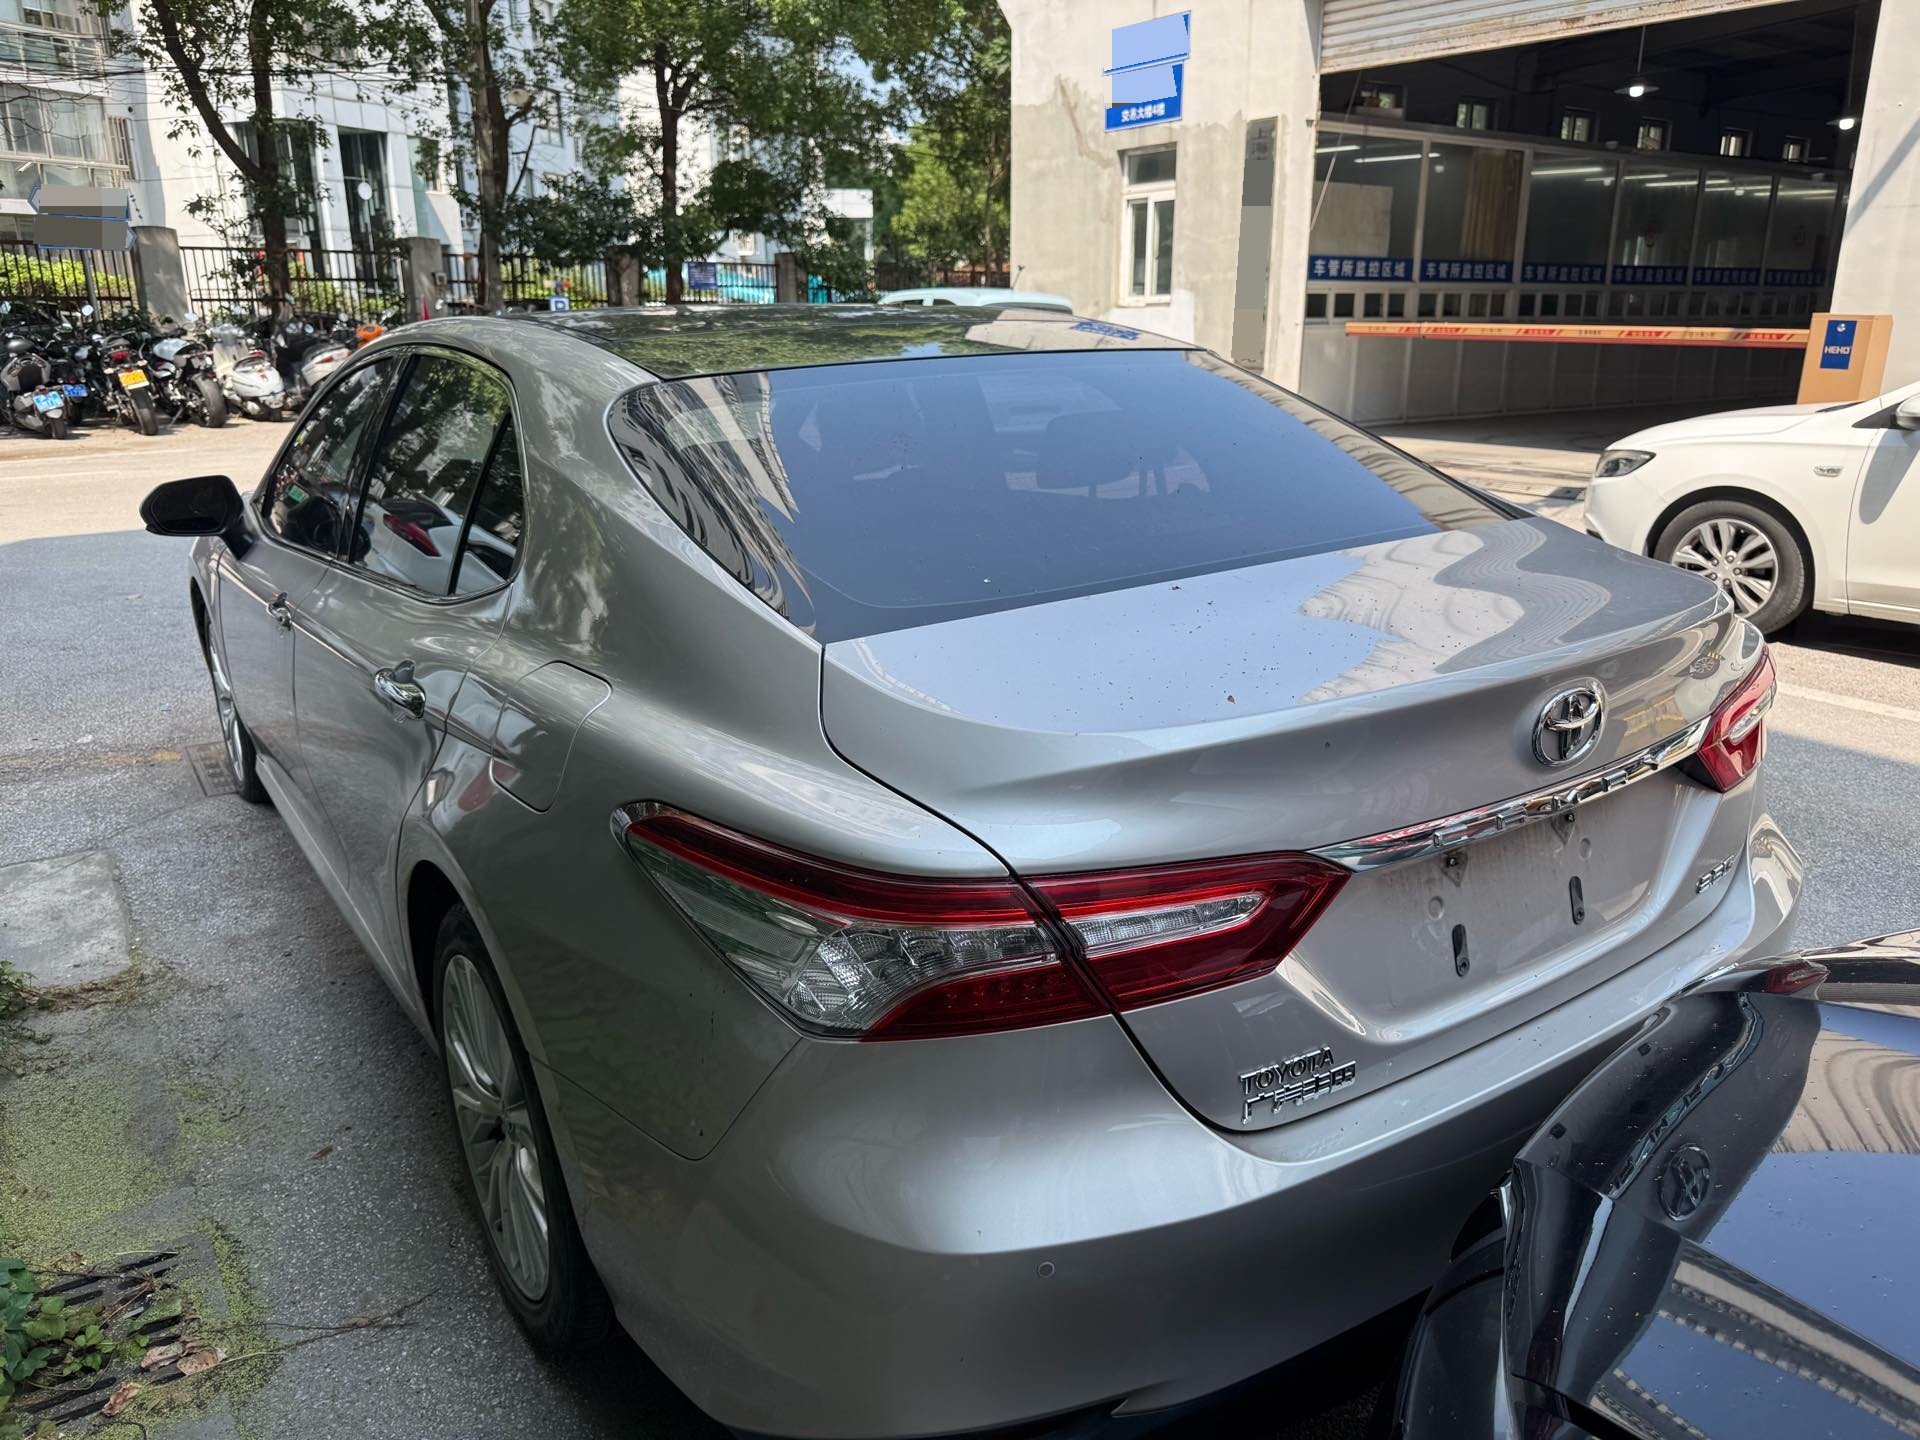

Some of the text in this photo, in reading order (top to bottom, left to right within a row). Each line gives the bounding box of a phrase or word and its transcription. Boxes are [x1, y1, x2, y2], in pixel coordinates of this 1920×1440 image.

[1313, 259, 1405, 277] 车管所监控区域
[1426, 262, 1506, 279] 车管所监控区域
[1239, 1046, 1335, 1095] TOYOTA
